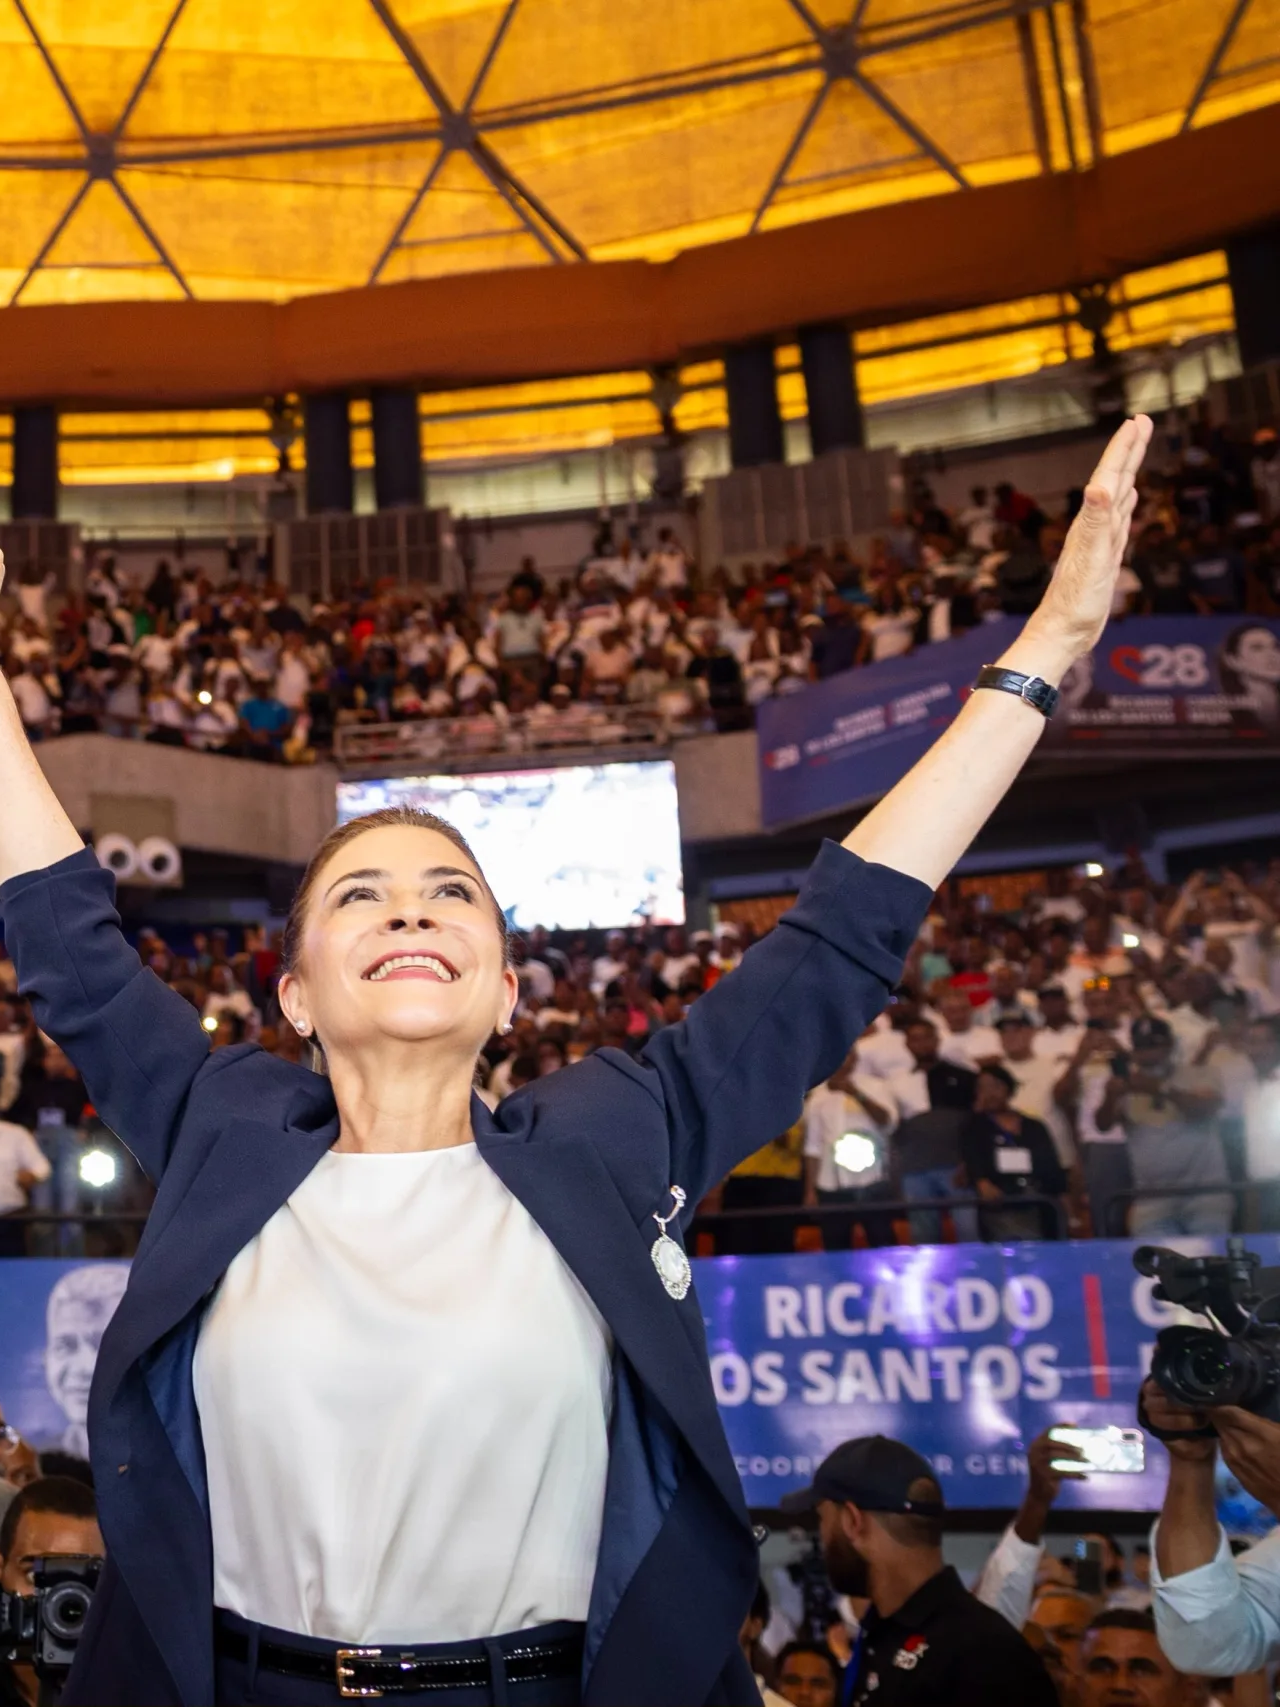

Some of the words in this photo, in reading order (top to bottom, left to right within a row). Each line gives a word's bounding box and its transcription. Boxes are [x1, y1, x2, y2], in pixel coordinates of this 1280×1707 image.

[1140, 643, 1209, 688] 28
[764, 1274, 1054, 1340] RICARDO
[800, 1343, 1062, 1406] SANTOS
